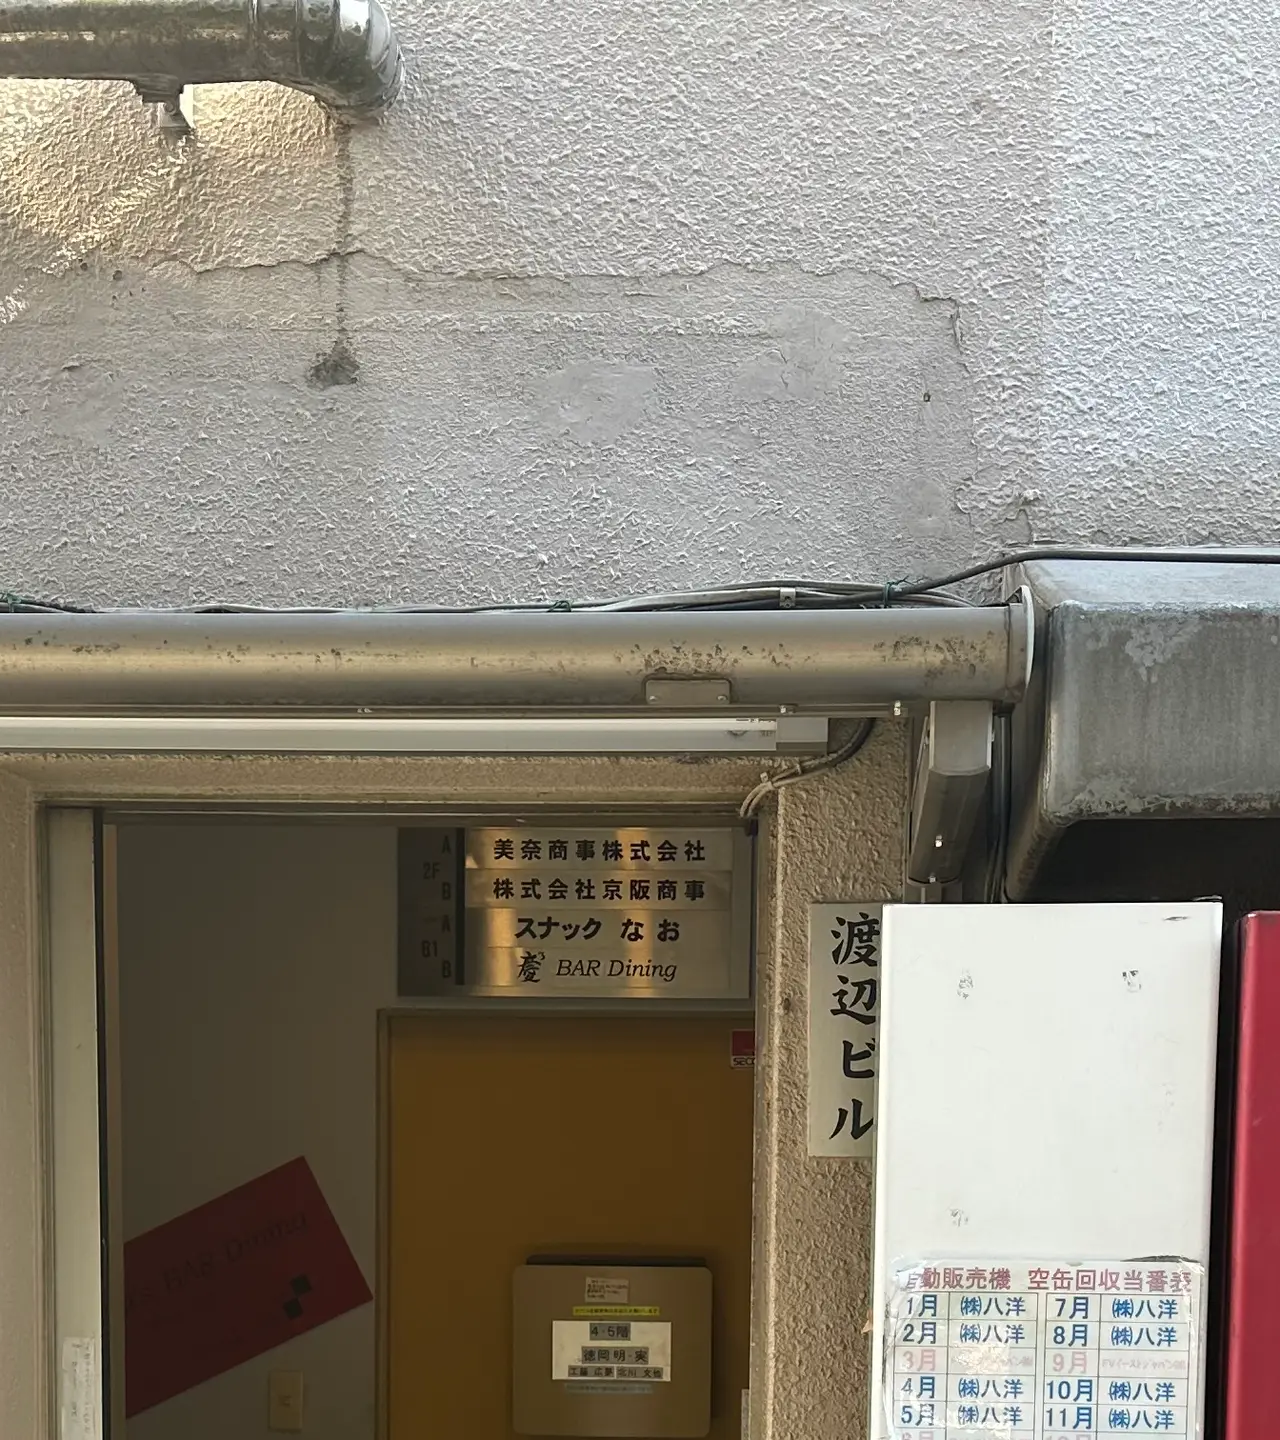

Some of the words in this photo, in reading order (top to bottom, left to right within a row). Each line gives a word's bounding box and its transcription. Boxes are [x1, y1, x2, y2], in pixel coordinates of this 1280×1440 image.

[493, 838, 706, 861] 美奈商事株式会社
[493, 878, 706, 901] 株式会社京阪商事
[515, 917, 602, 941] スナック
[620, 918, 680, 943] なお
[556, 959, 601, 977] BAR
[607, 959, 677, 982] Dining
[829, 912, 881, 1141] 渡辺ビル
[1028, 1269, 1192, 1293] 空缶回収当番表
[907, 1294, 938, 1317] 1月
[1055, 1297, 1090, 1320] 7月
[902, 1322, 937, 1345] 2月
[1053, 1324, 1089, 1347] 8月
[902, 1349, 936, 1372] 3月
[1052, 1351, 1088, 1372] 9月
[901, 1376, 936, 1399] 4月
[1046, 1379, 1093, 1402] 10月
[901, 1403, 935, 1427] 5月
[1046, 1407, 1092, 1430] 11月
